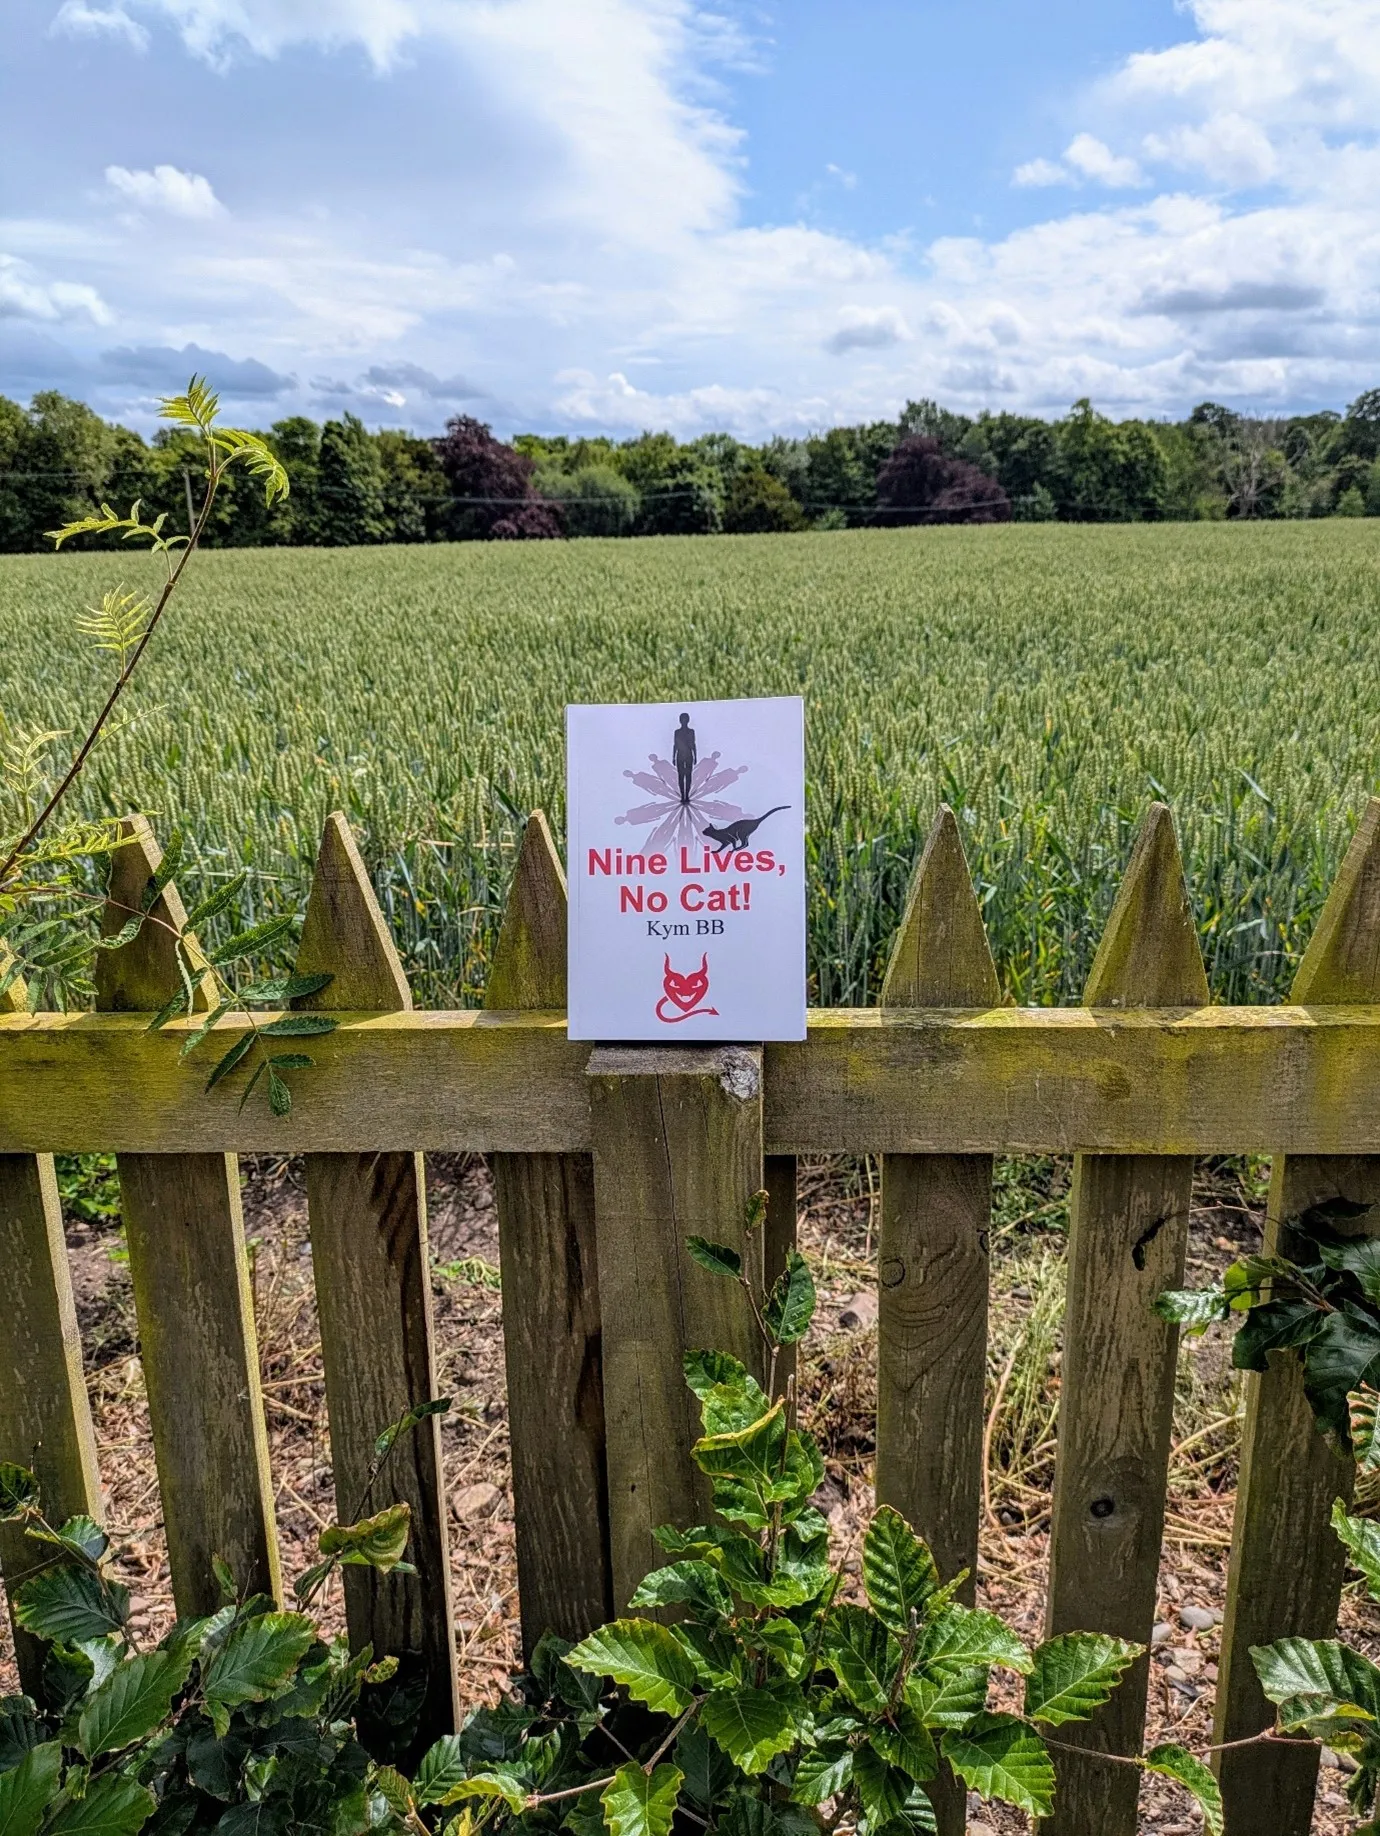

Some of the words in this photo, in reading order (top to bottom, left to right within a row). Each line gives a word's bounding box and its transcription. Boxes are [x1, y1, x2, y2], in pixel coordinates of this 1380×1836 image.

[588, 848, 667, 875] Nine
[680, 846, 786, 876] Lives,
[620, 885, 668, 913] No
[680, 883, 751, 912] Cat!
[646, 919, 690, 940] Kym
[695, 919, 725, 936] BB
